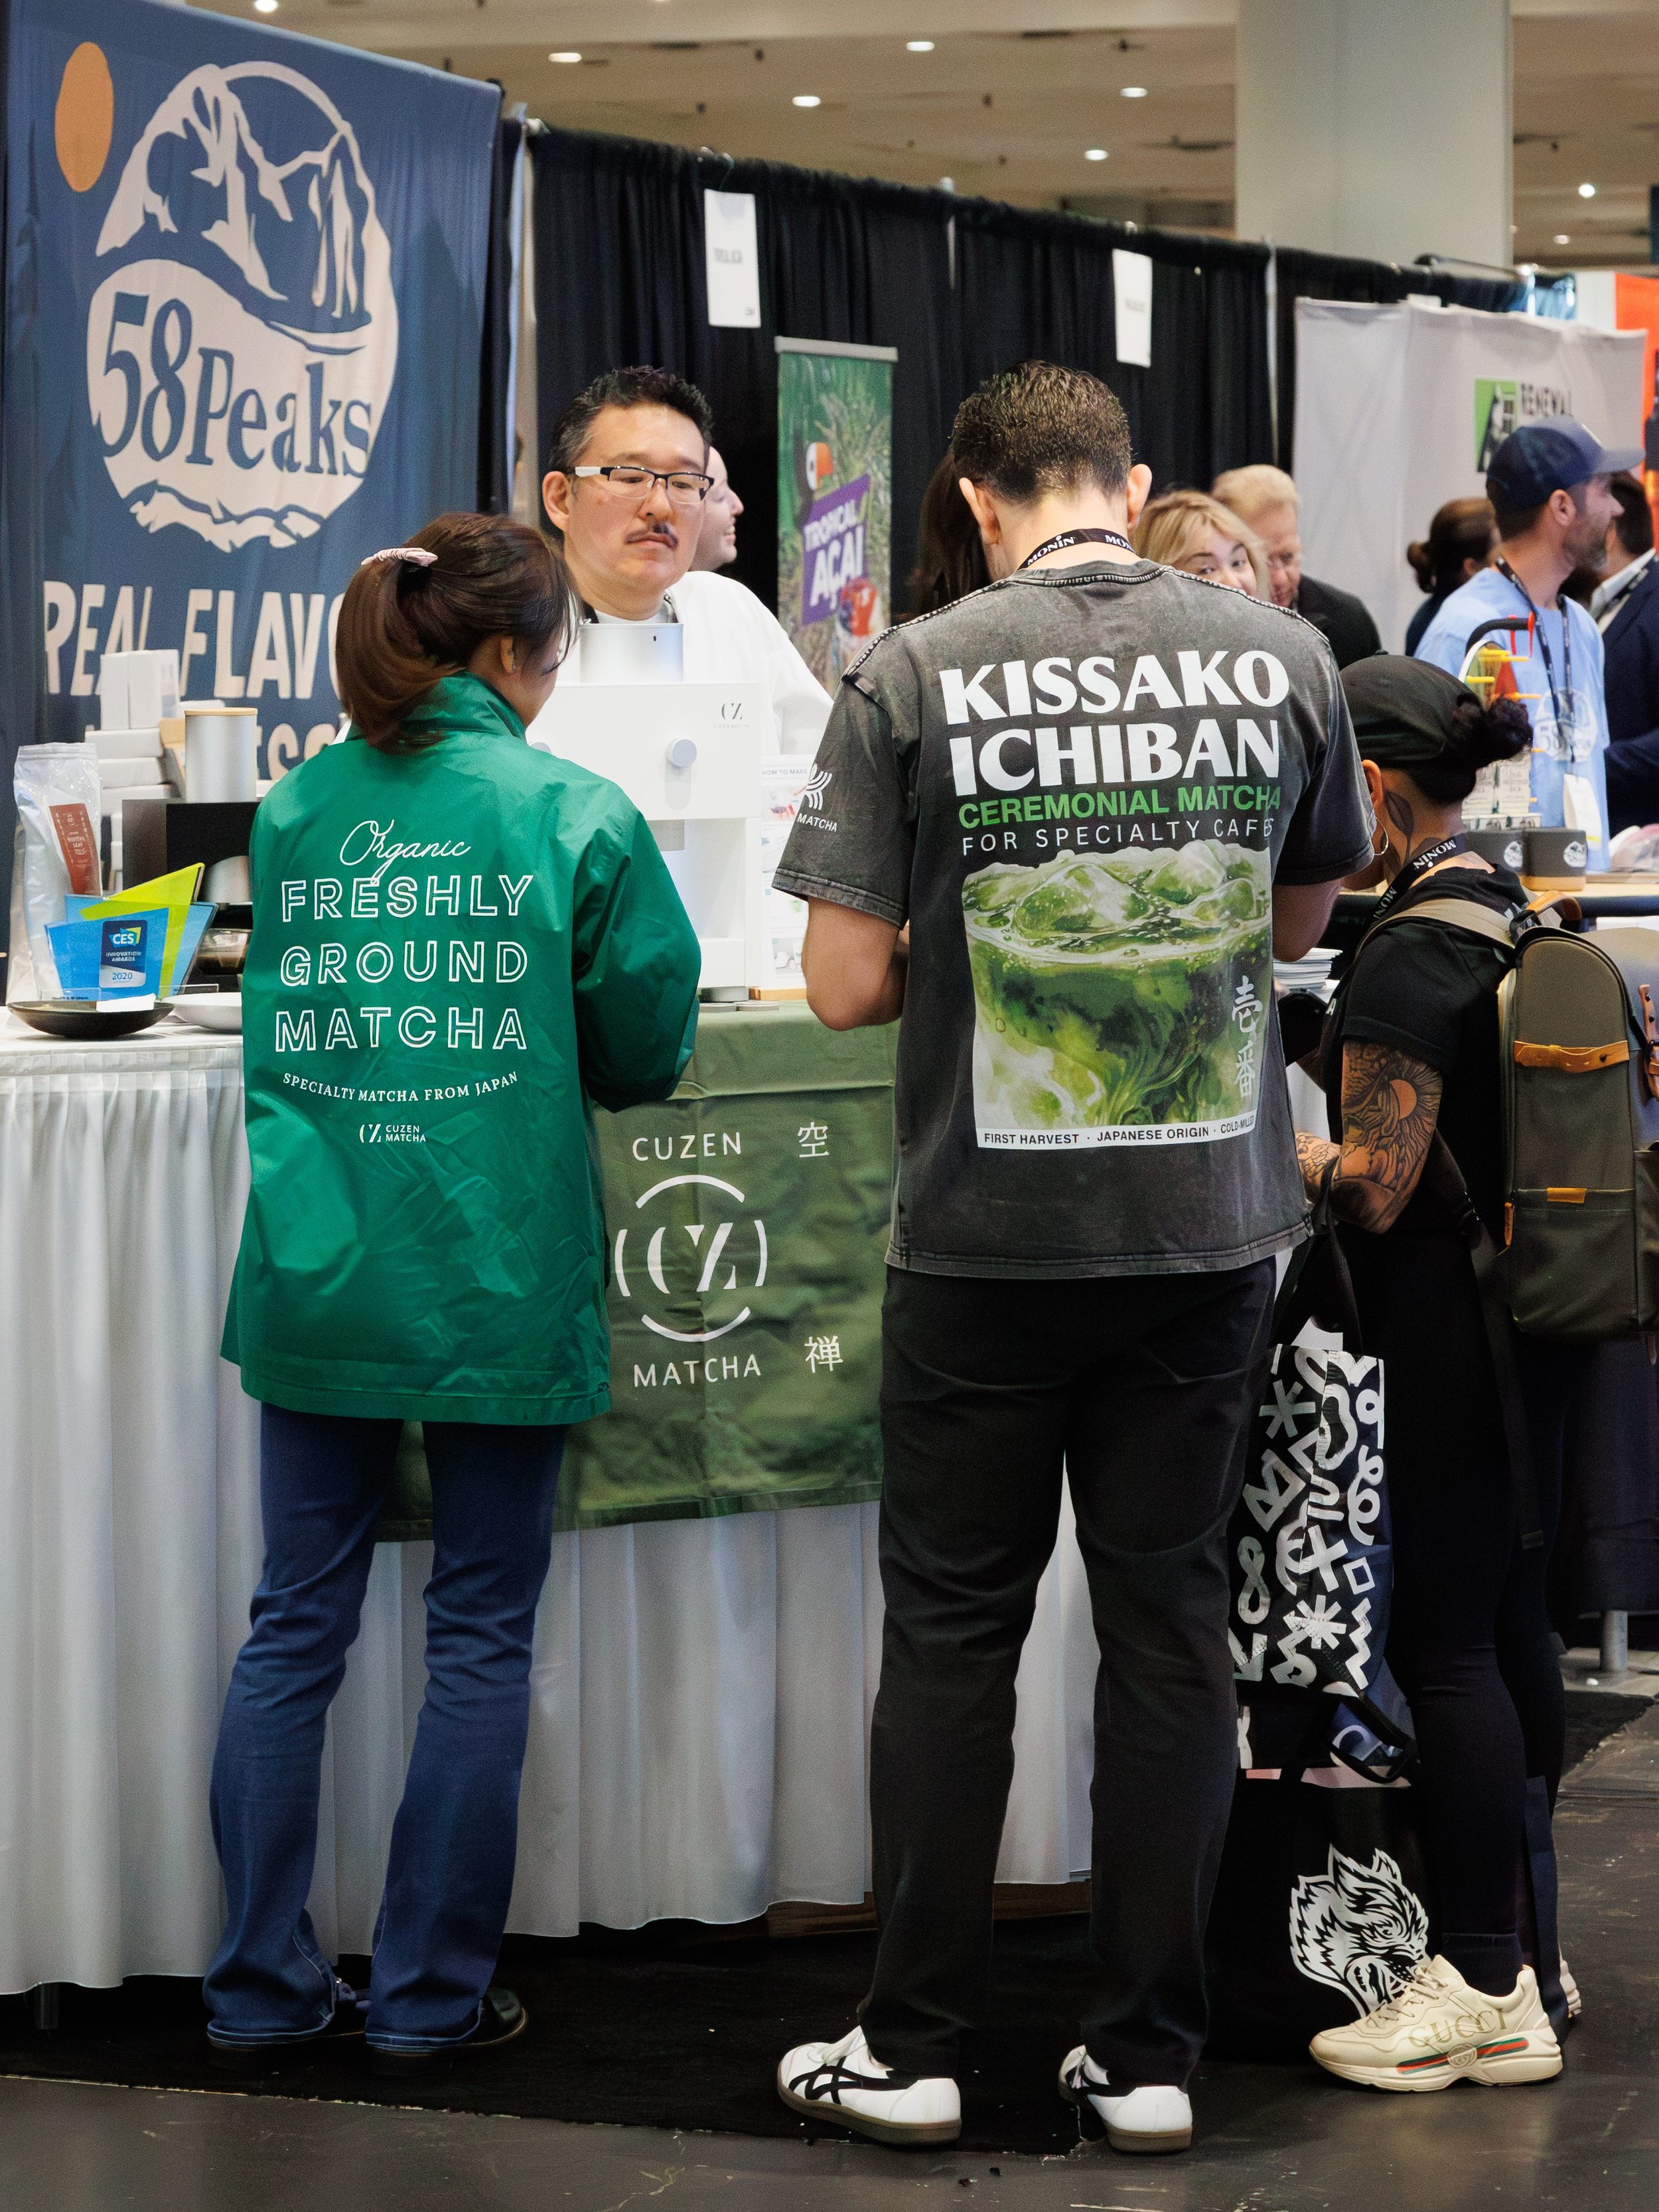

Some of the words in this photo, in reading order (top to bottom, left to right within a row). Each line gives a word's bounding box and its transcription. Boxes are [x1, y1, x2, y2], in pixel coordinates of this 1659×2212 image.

[98, 291, 372, 479] 58Peaks
[939, 650, 1290, 725] KISSAKO
[949, 718, 1279, 796] ICHIBAN
[796, 813, 838, 832] MATCHA
[959, 788, 1170, 829] CEREMONIAL
[1178, 784, 1281, 813] MATCHA
[339, 818, 472, 885] Organic
[962, 832, 1017, 856] FOR
[1037, 820, 1201, 848] SPECIALTY
[281, 874, 534, 922] FRESHLY
[112, 933, 134, 945] CES
[280, 940, 528, 986] GROUND
[275, 1006, 527, 1052] MATCHA
[283, 1072, 356, 1101] SPECIALTY
[358, 1089, 419, 1102] MATCHA
[425, 1084, 469, 1101] FROM
[476, 1071, 518, 1096] JAPAN
[386, 1124, 420, 1134] CUZEN
[386, 1133, 426, 1143] MATCHA
[632, 1132, 741, 1161] CUZEN
[797, 1122, 830, 1158] 空
[984, 1133, 1015, 1145] FIRST
[1020, 1134, 1080, 1145] HARVEST
[1097, 1130, 1163, 1142] JAPANESE
[1167, 1126, 1210, 1140] ORIGIN
[633, 1354, 761, 1387] MATCHA
[804, 1335, 843, 1374] 禅
[1408, 2008, 1507, 2048] GUCCI
